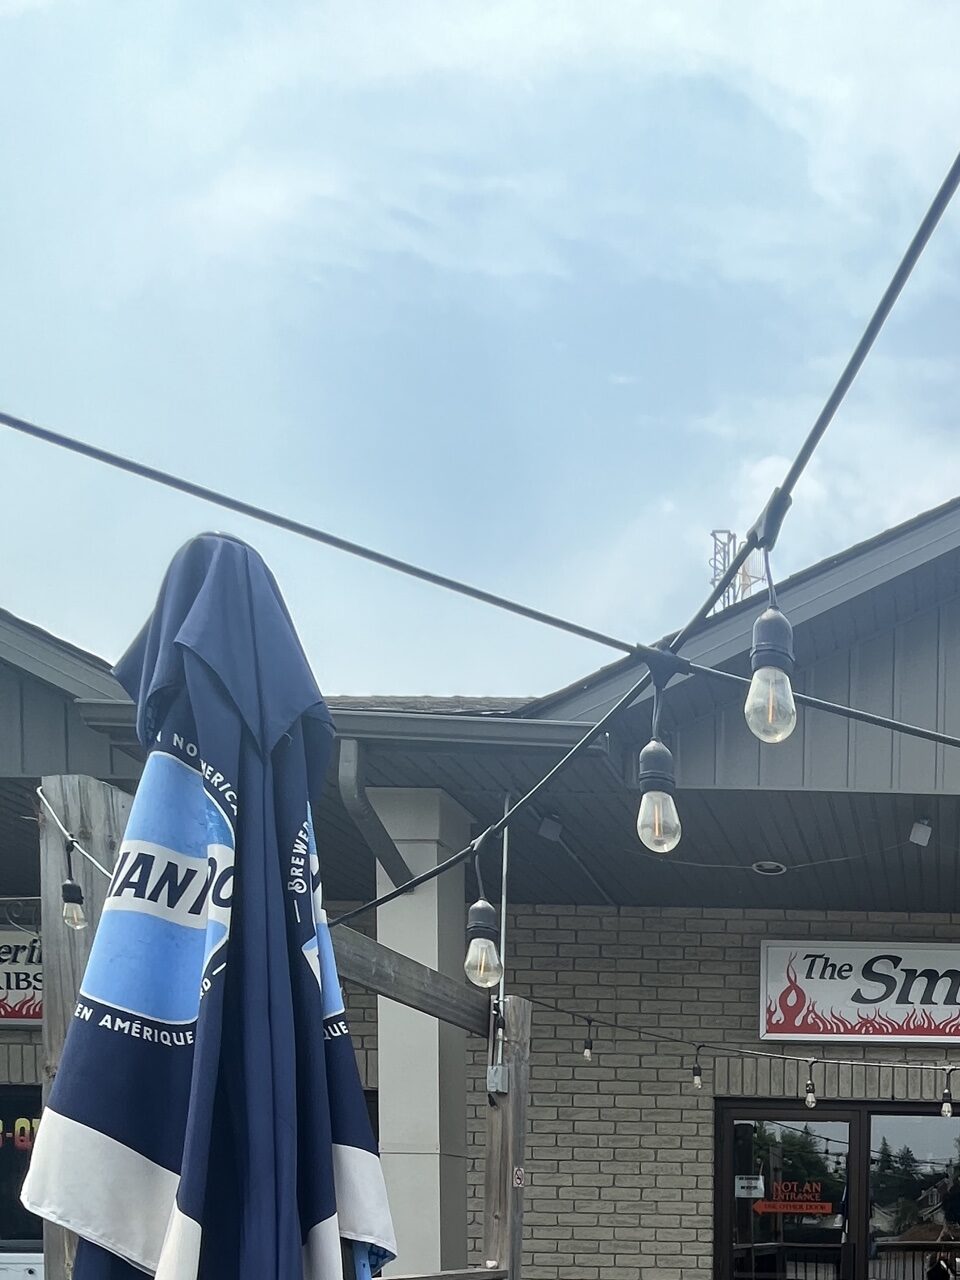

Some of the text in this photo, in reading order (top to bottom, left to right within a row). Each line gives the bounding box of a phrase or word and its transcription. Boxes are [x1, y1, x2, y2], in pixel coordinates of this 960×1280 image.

[803, 953, 853, 980] The
[0, 971, 42, 991] IBS
[74, 1002, 194, 1047] EN AMÉRIQUE
[772, 1192, 822, 1201] ENTRANCE
[773, 1181, 821, 1193] NOT AN
